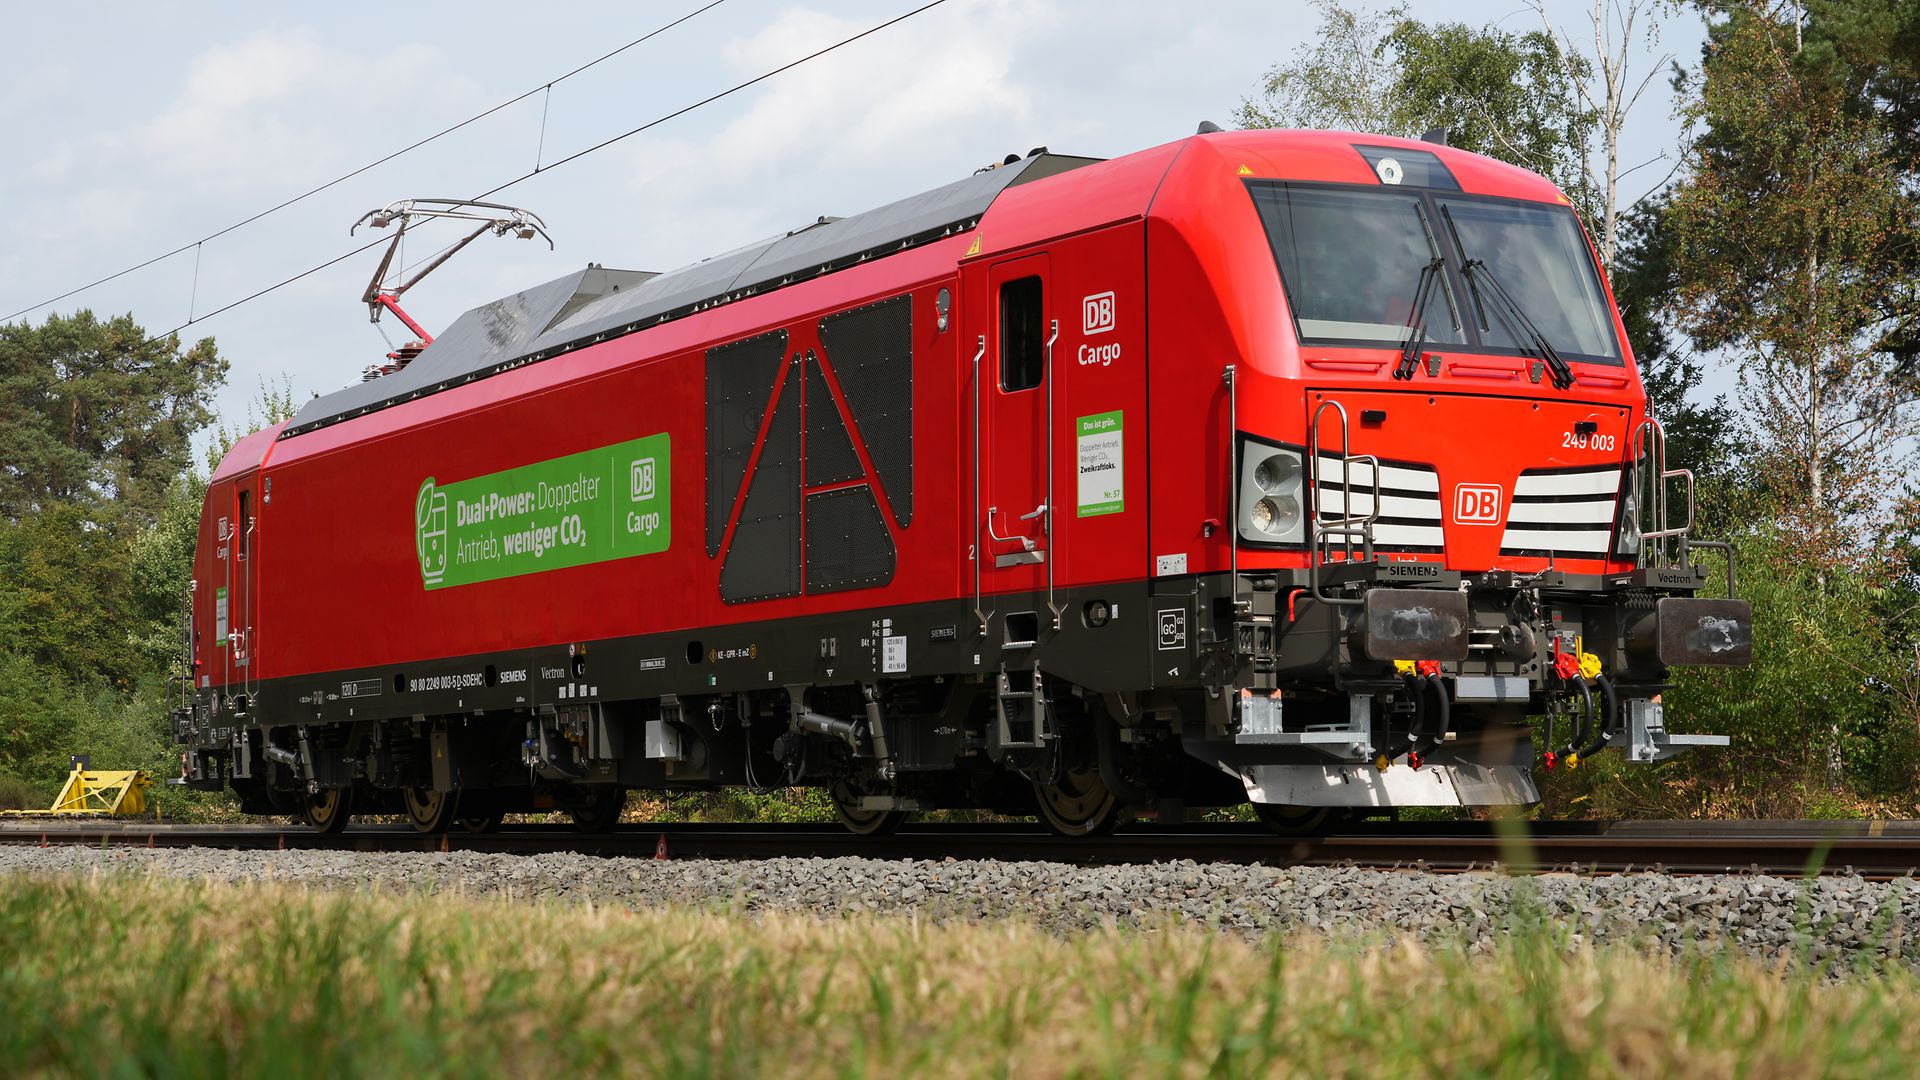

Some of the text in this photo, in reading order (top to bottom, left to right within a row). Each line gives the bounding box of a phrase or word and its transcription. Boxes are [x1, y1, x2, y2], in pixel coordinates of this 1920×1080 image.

[1086, 298, 1112, 329] DB
[1078, 343, 1121, 367] Cargo
[1083, 422, 1094, 431] Das
[1094, 420, 1102, 429] ist
[1562, 431, 1615, 452] 249 003
[1080, 462, 1117, 474] Zweikraftloks.
[632, 463, 654, 496] DB
[456, 472, 601, 527] Dual-Power: Doppelter
[1104, 489, 1121, 499] Nr. 57
[1460, 490, 1496, 518] DB
[627, 511, 660, 537] Cargo
[456, 530, 502, 565] Antrieb,
[503, 521, 558, 558] weniger
[217, 545, 228, 560] Carg
[968, 544, 975, 561] 2
[1389, 565, 1439, 578] SIEMENS
[1657, 572, 1692, 585] Vectron
[1176, 617, 1184, 625] G2
[931, 628, 954, 638] SIEMENS
[1163, 624, 1175, 635] GC
[500, 669, 527, 684] SIEMENS
[541, 666, 565, 680] Vectron
[410, 672, 483, 692] 90 80 2249 003-5 D-SDEHC
[342, 684, 351, 697] 120
[352, 683, 358, 696] D
